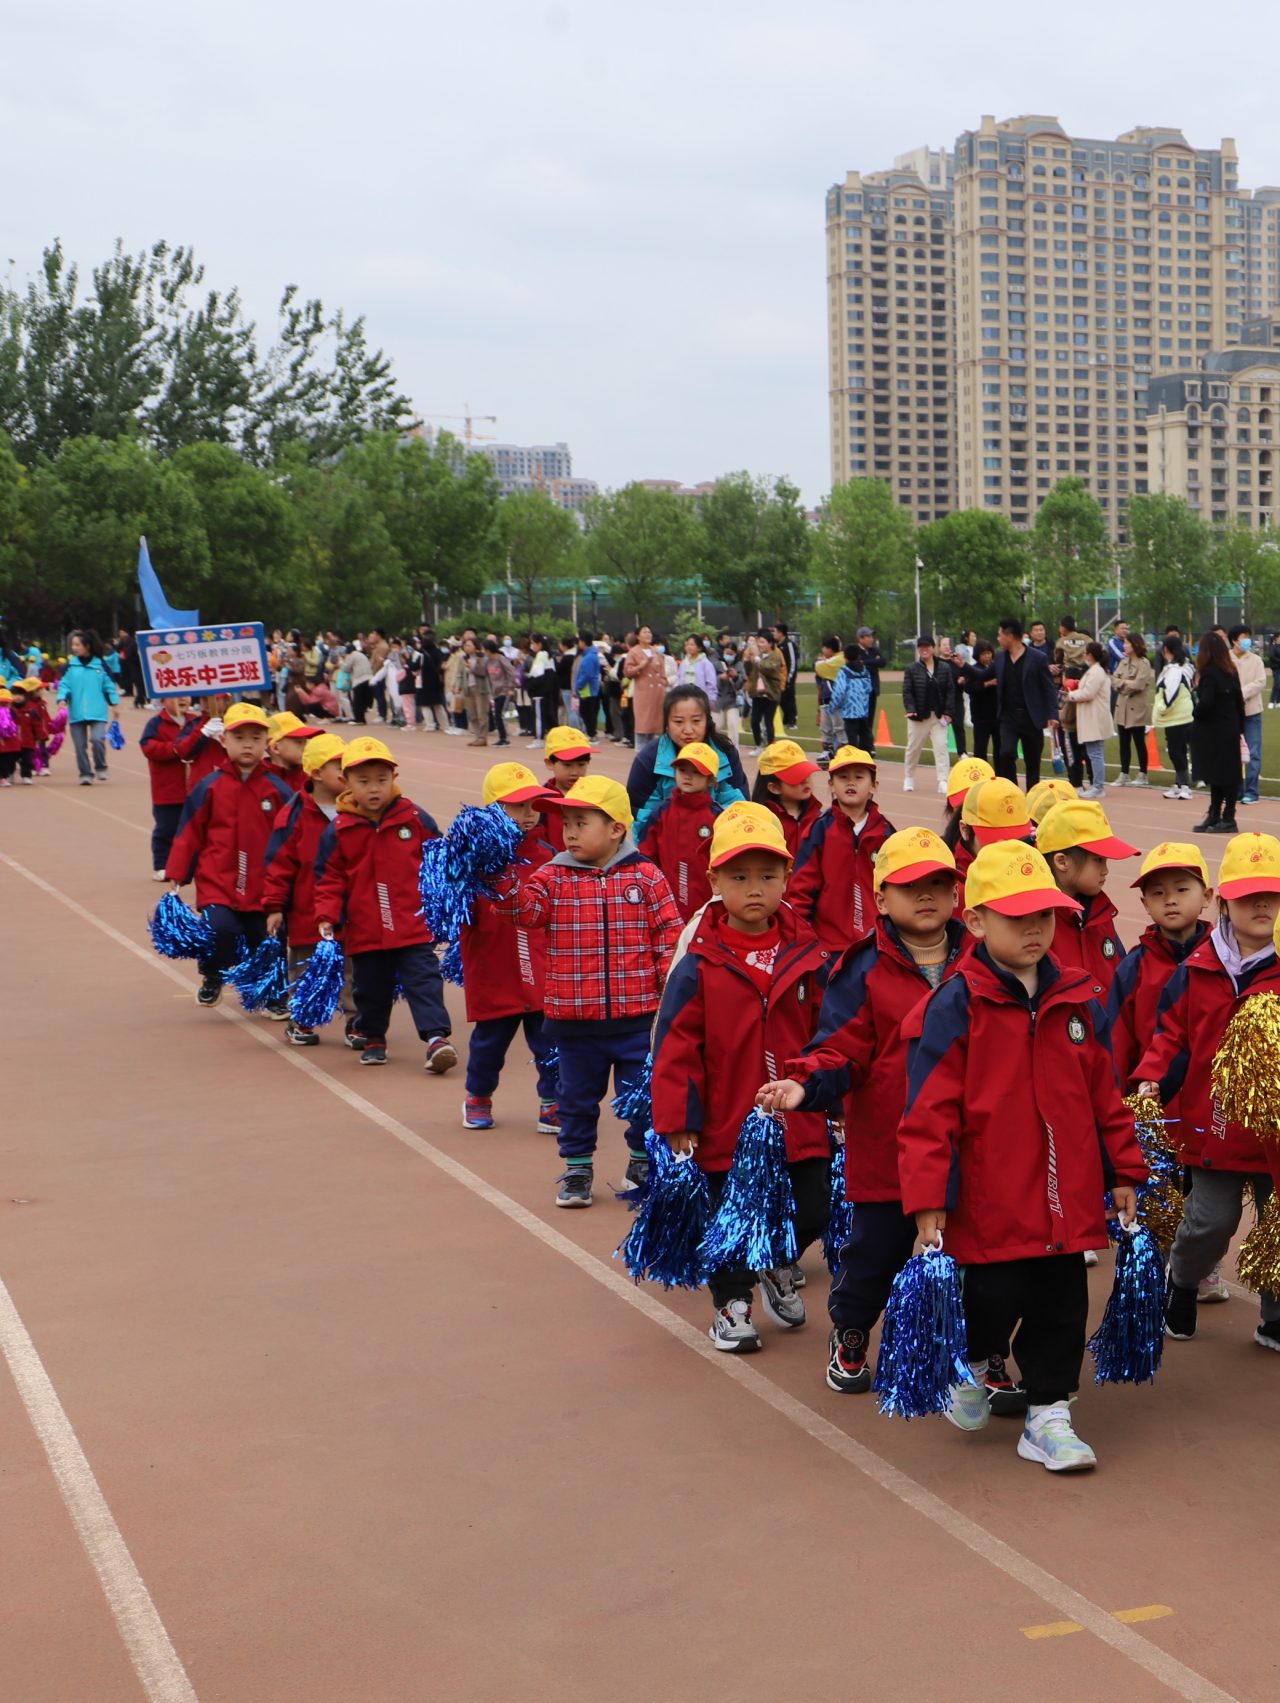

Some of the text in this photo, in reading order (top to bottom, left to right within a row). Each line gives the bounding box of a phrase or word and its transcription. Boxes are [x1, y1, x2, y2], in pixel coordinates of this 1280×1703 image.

[155, 660, 260, 688] 快乐中三班
